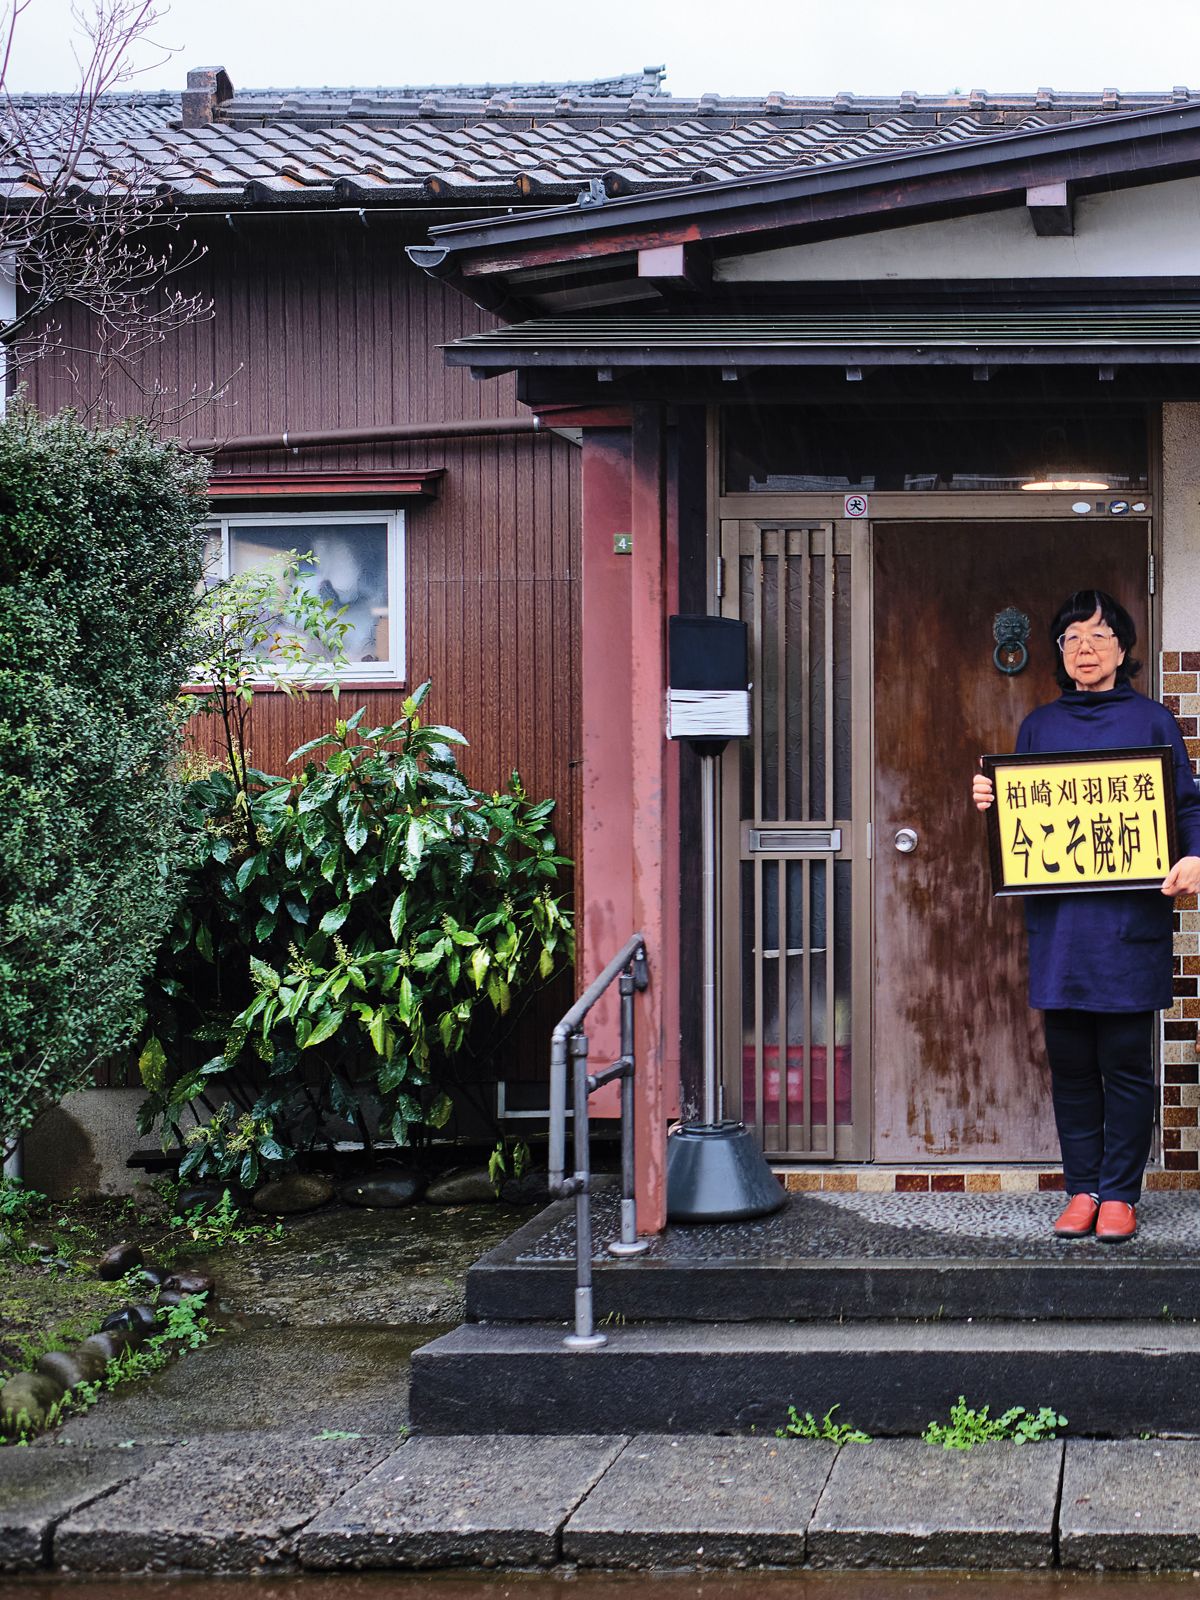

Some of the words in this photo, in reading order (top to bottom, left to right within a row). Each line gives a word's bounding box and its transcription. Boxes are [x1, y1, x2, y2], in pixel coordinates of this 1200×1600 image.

[850, 499, 863, 511] 犬
[1006, 773, 1155, 809] 柏崎刈羽原発
[1011, 809, 1162, 878] 今こそ廃炉！
